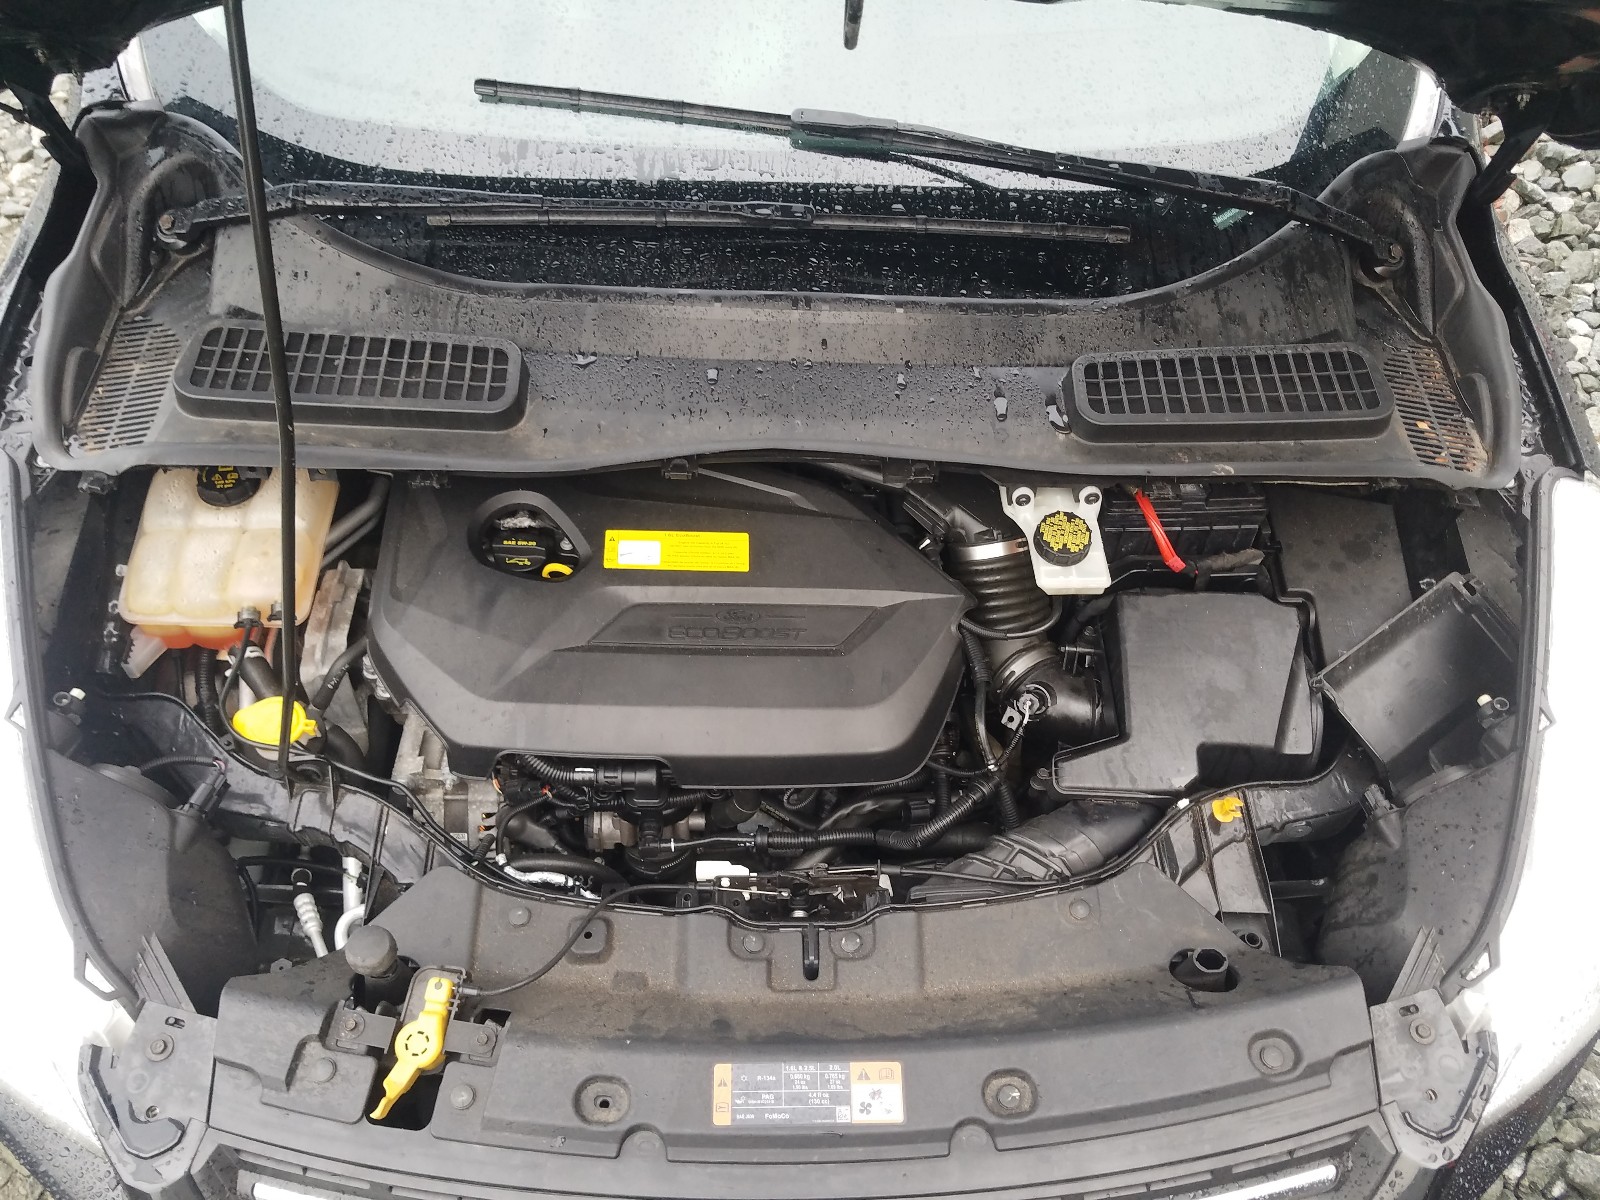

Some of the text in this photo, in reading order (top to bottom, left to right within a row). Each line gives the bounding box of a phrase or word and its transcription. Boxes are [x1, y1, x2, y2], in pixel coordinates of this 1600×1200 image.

[668, 625, 807, 641] ECOBOOST
[803, 1073, 811, 1081] kg
[764, 1112, 790, 1120] FoMoCo
